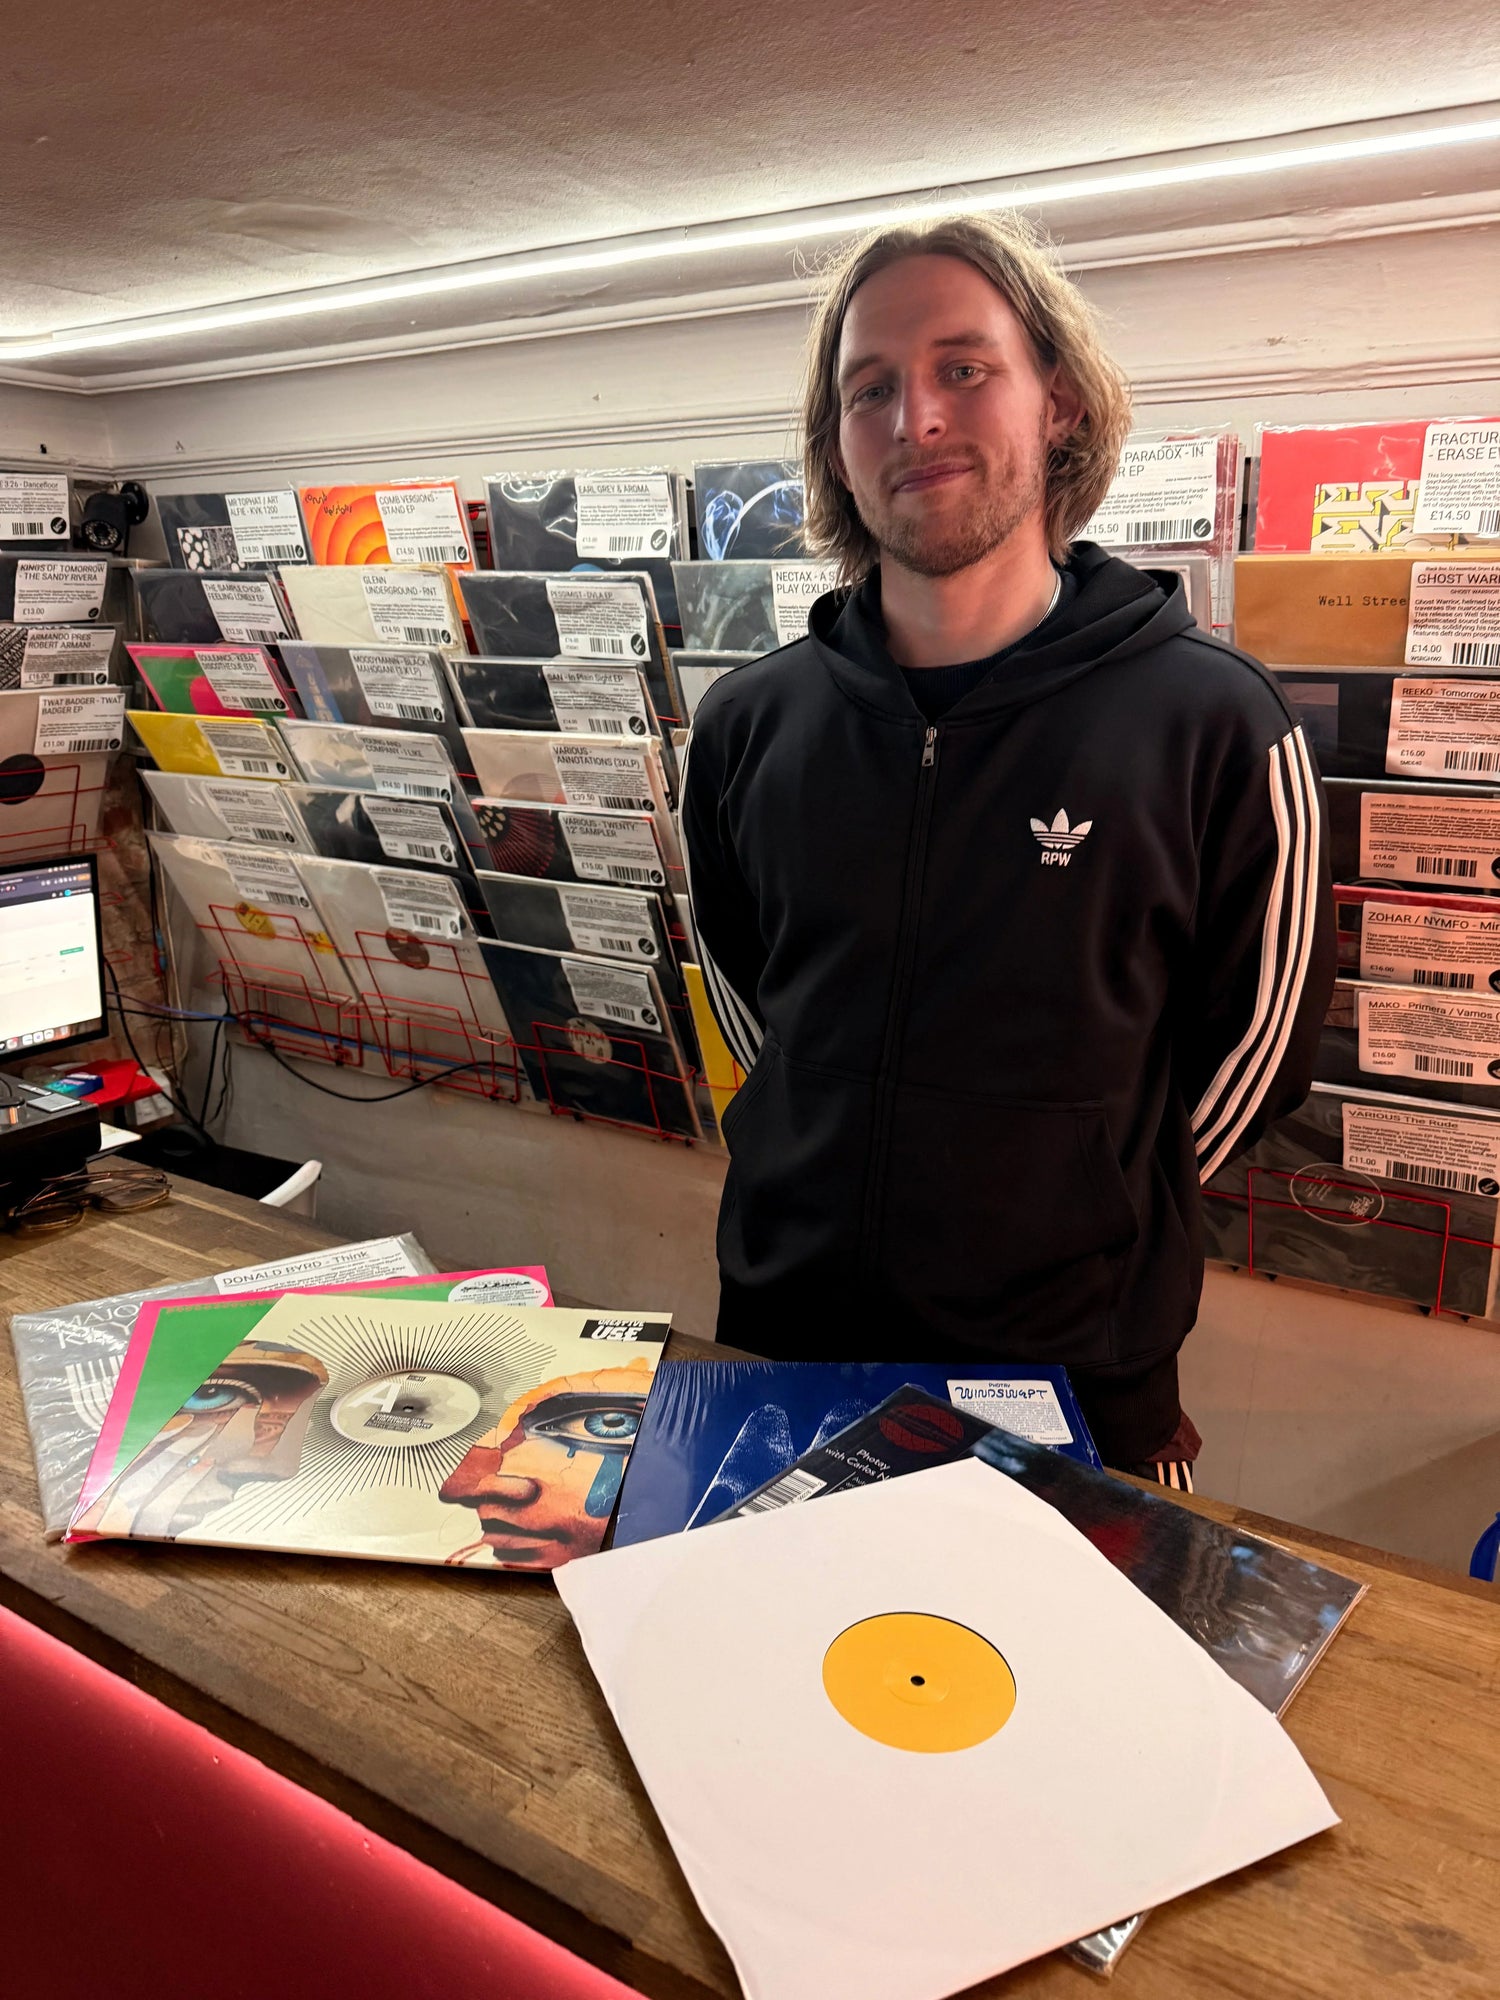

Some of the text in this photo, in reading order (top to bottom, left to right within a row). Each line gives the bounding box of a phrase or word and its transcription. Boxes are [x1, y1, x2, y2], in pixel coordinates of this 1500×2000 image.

[1430, 432, 1500, 447] FRACTUR
[1124, 448, 1182, 463] PARADOX
[1191, 446, 1205, 458] IN
[1437, 447, 1486, 461] ERASE
[1128, 464, 1145, 477] EP
[23, 481, 59, 490] Dancefloor
[578, 485, 596, 494] EARL
[597, 485, 616, 494] GREY
[623, 484, 650, 493] AROMA
[228, 497, 239, 506] MR
[238, 496, 262, 506] TOPHAT
[267, 495, 279, 504] ART
[304, 491, 328, 504] comb
[379, 493, 435, 504] COMB VERSIONS
[230, 506, 278, 516] ALFIE KVK 1200
[381, 505, 416, 515] STAND EP
[1429, 510, 1471, 521] £14.50
[1086, 523, 1119, 535] £15.50
[396, 546, 415, 556] £14.50
[20, 563, 104, 574] KINGS OF TOMORROW
[42, 573, 69, 581] SANDY
[363, 575, 387, 585] GLENN
[775, 572, 828, 582] NECTAX A
[1417, 574, 1464, 584] GHOST
[365, 586, 437, 596] UNDERGROUND RNT
[776, 584, 799, 594] PLAY
[1319, 595, 1408, 607] Well Stree
[30, 633, 92, 641] ARMANDO PRES
[28, 641, 91, 649] ROBERT ARMANI
[1411, 644, 1442, 654] £14.00
[1402, 687, 1434, 697] REEKO
[1440, 689, 1488, 699] Tomorrow
[43, 696, 122, 707] TWAT BADGER TWAT
[42, 707, 72, 716] BADGER
[553, 746, 589, 756] VARIOUS
[1400, 749, 1426, 757] £16.00
[556, 757, 641, 770] ANNOTATIONS (3XLP)
[563, 816, 597, 828] VARIOUS
[579, 827, 618, 838] SAMPLER
[1040, 851, 1072, 867] RPW
[1368, 911, 1412, 923] ZOHAR
[1423, 915, 1469, 930] NYMFO
[1368, 1000, 1400, 1010] MAKO
[1408, 1002, 1447, 1015] Primera
[1456, 1008, 1493, 1020] Vamos
[1372, 1052, 1397, 1060] £16.00
[1348, 1109, 1459, 1130] VARIOUS The Rude
[1348, 1155, 1377, 1166] £11.00
[222, 1249, 370, 1286] DONALD BYRD Think
[590, 1325, 645, 1343] USE
[346, 1379, 402, 1413] A
[825, 1447, 893, 1482] with Carlos N
[856, 1448, 891, 1472] Photay
